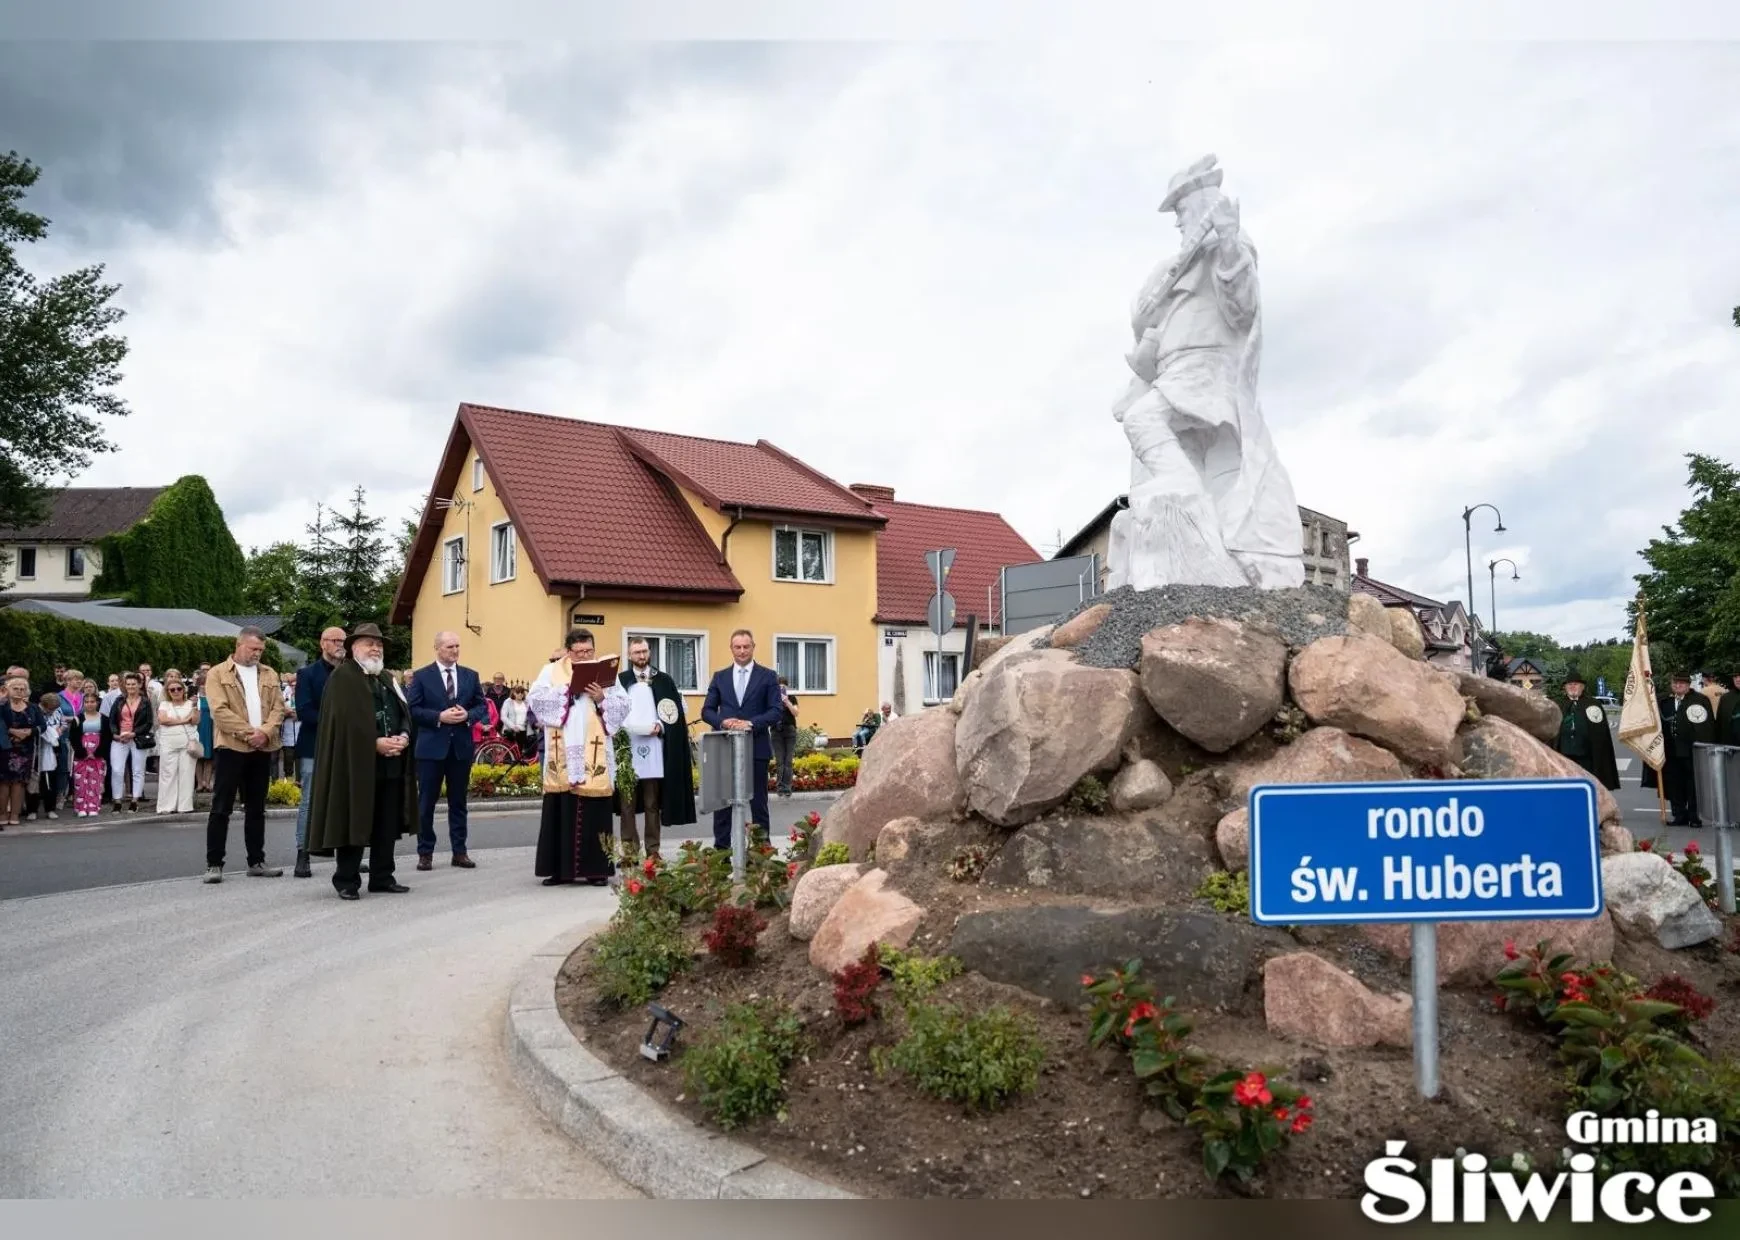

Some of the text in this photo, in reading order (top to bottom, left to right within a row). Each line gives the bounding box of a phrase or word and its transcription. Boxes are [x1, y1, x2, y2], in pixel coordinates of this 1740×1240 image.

[1367, 797, 1485, 840] rondo
[1290, 854, 1563, 904] św. Huberta
